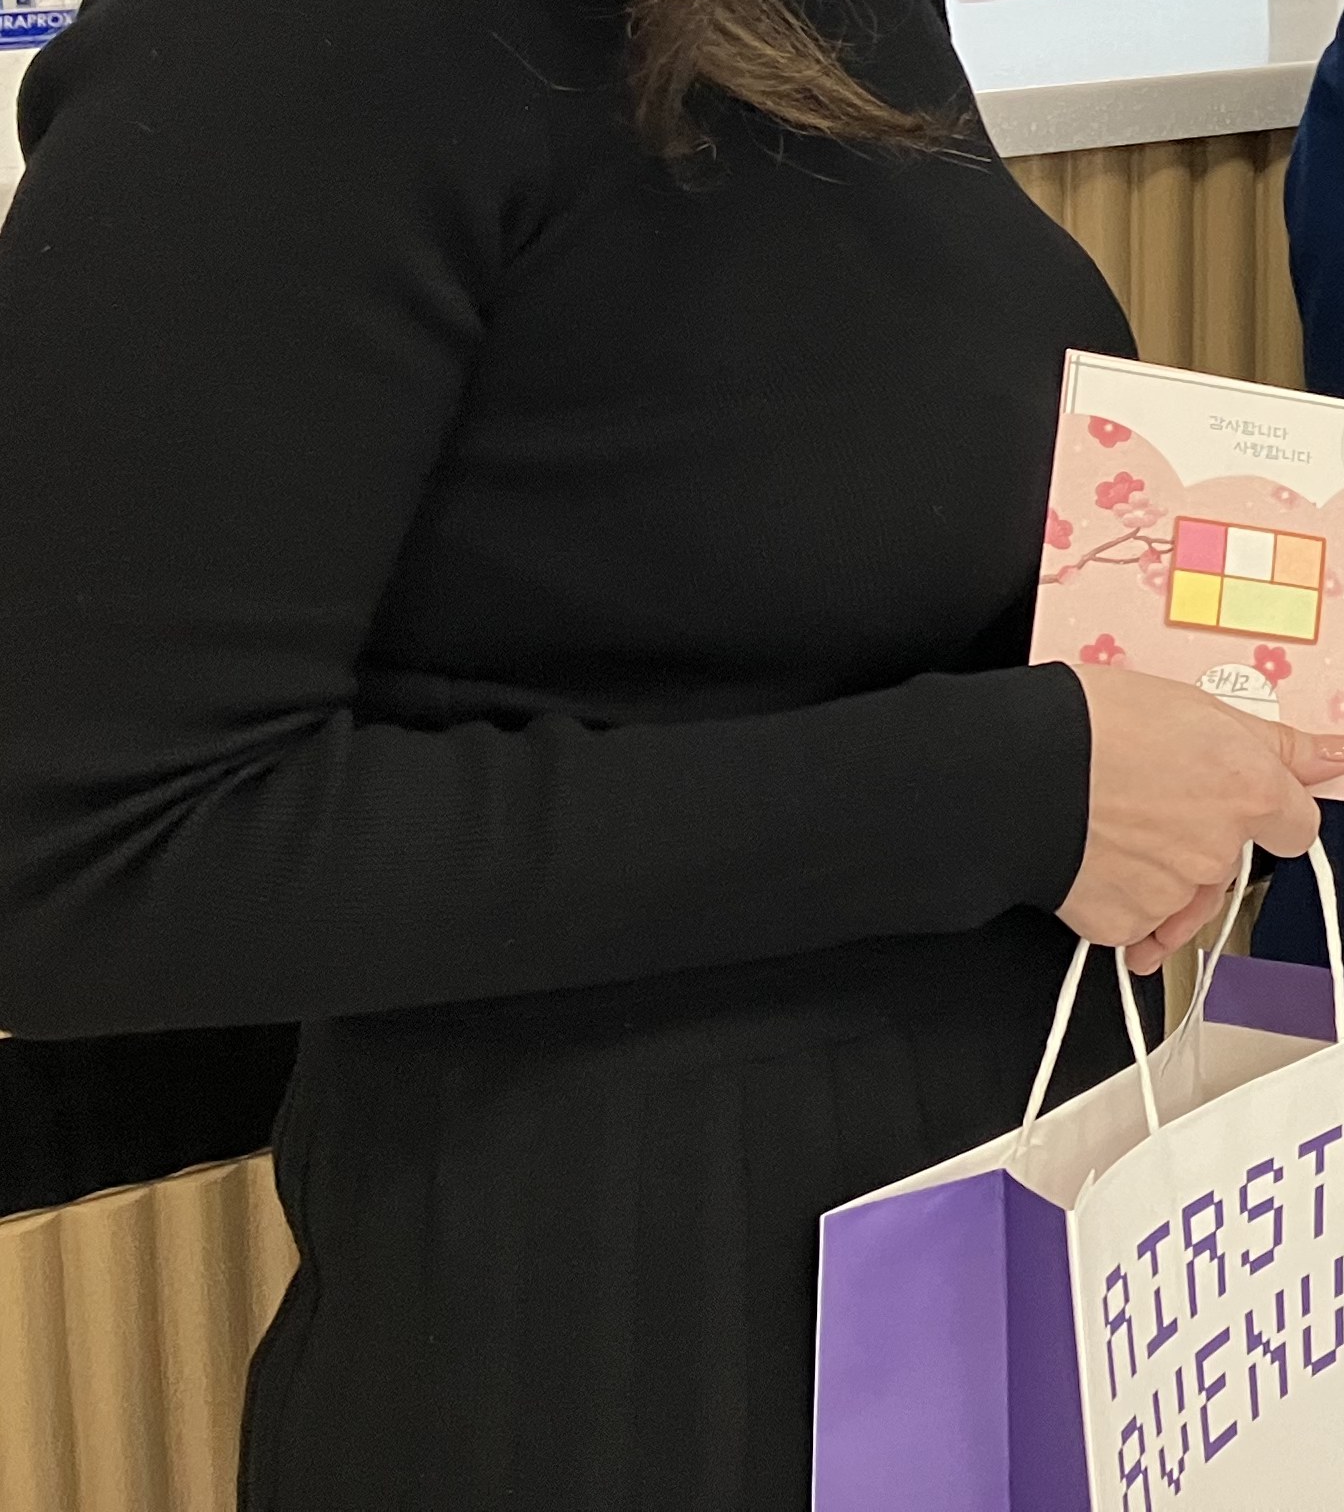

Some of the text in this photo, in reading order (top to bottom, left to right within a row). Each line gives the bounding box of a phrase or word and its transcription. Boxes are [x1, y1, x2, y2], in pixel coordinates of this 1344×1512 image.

[0, 12, 73, 29] RAPROX
[1208, 415, 1289, 440] 감사합니다
[1233, 441, 1313, 464] 사랑합니다
